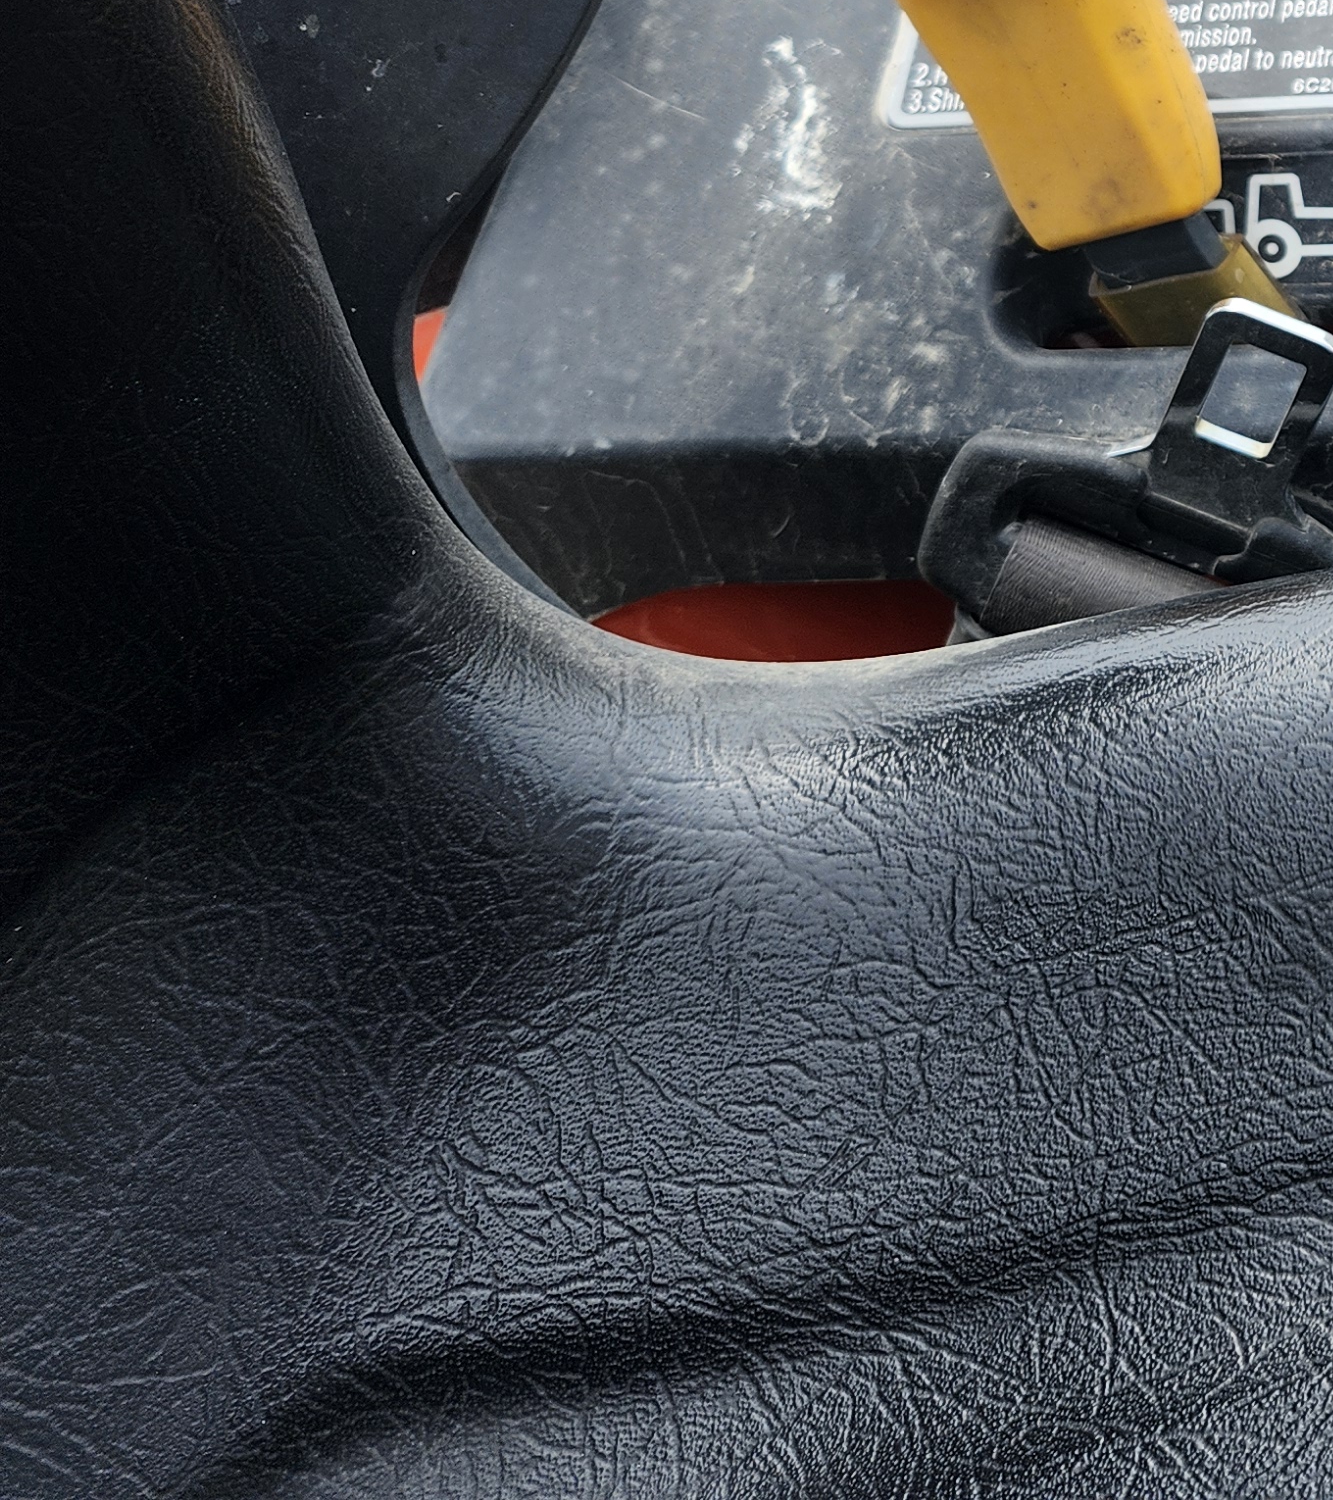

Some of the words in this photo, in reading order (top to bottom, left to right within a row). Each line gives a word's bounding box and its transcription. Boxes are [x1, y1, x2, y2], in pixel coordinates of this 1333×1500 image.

[1180, 23, 1257, 48] mission.
[1193, 47, 1251, 74] pedal
[1253, 47, 1275, 70] to
